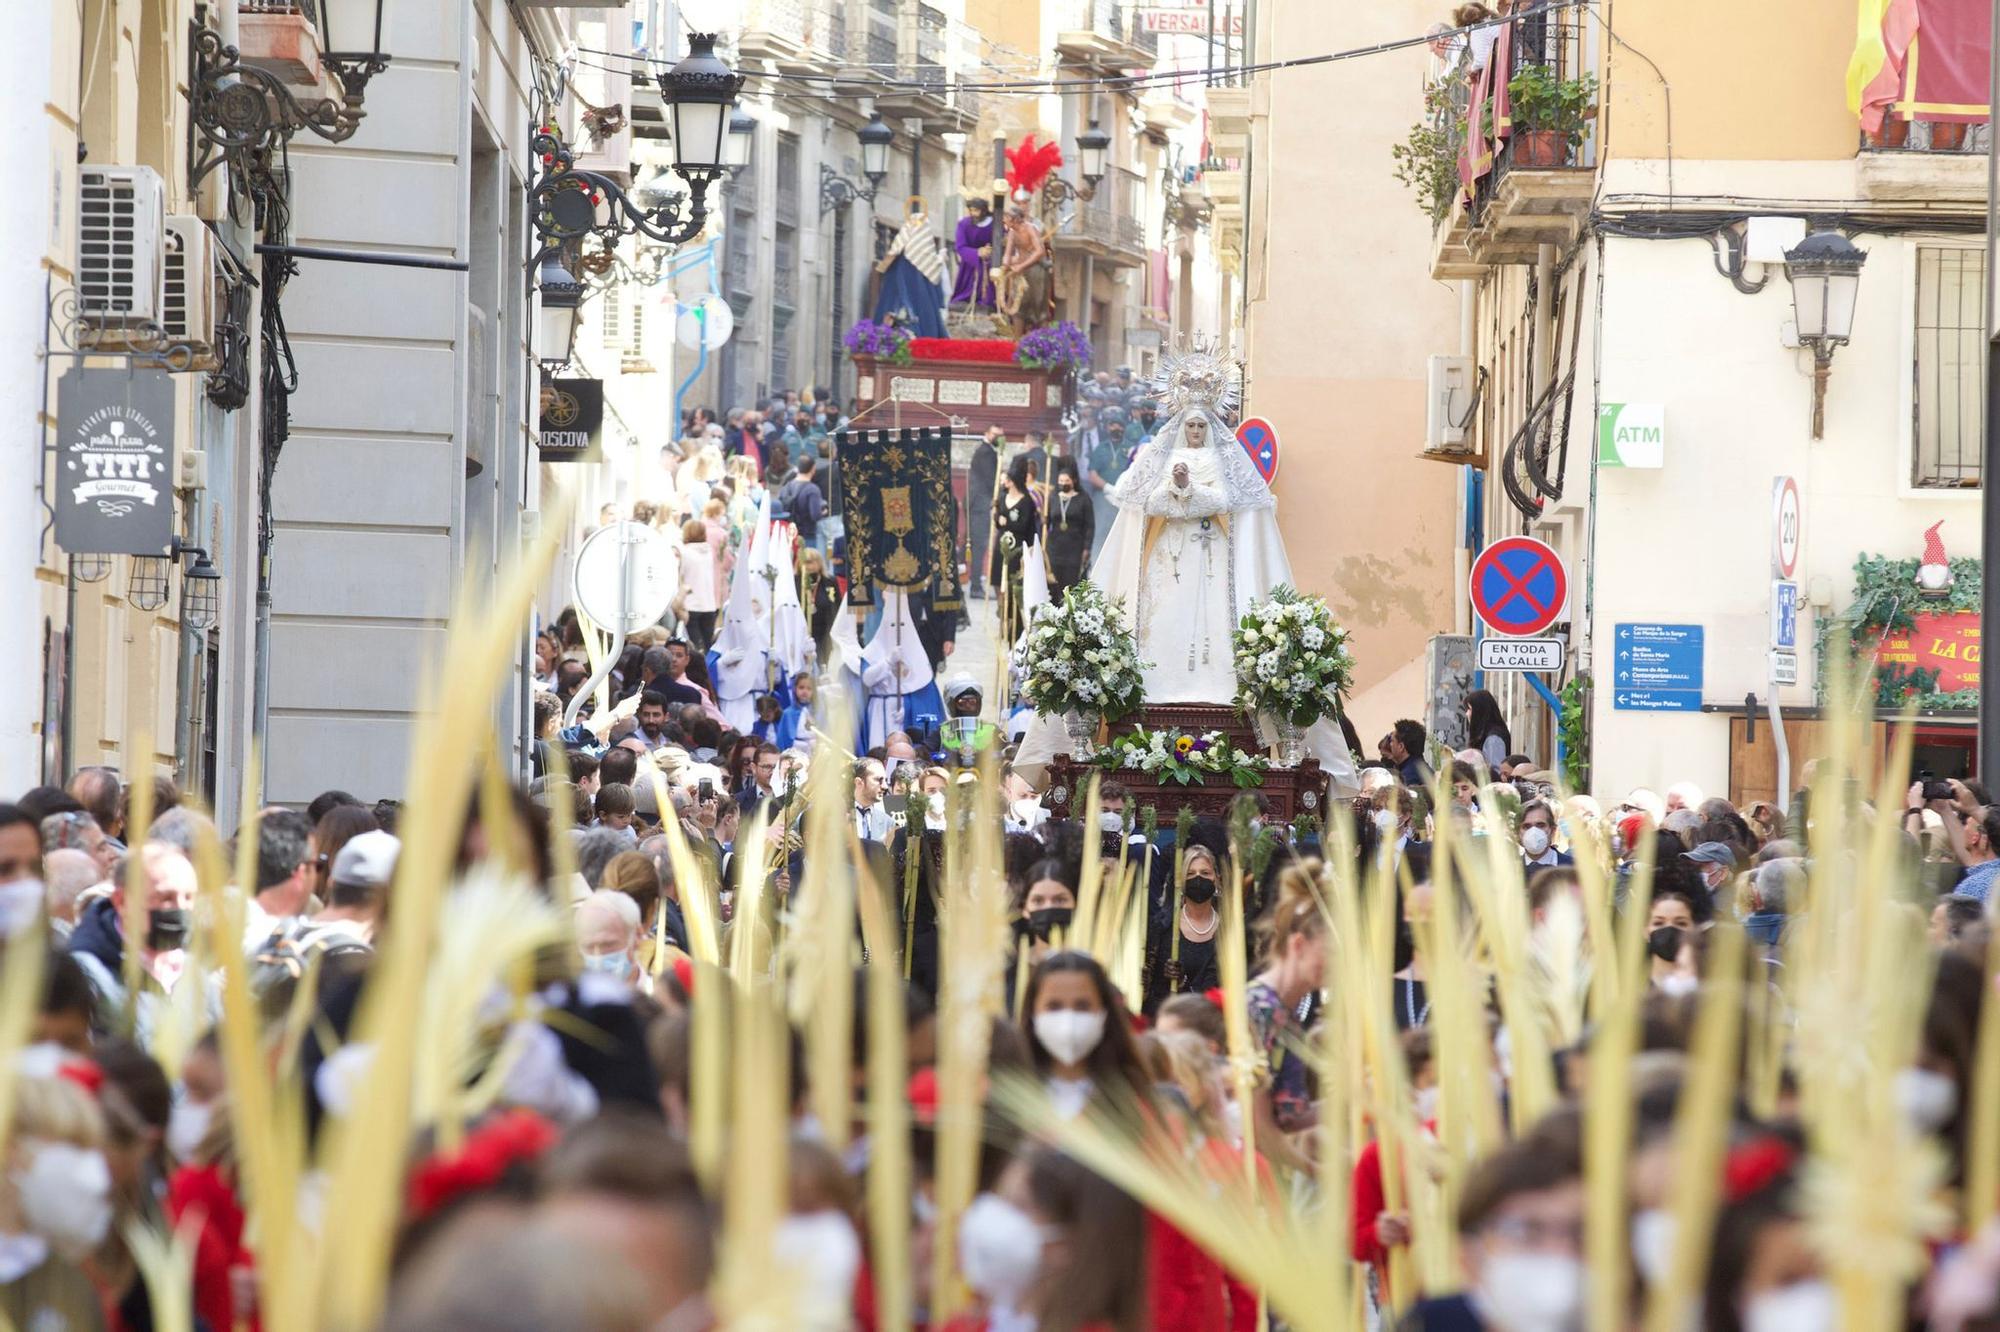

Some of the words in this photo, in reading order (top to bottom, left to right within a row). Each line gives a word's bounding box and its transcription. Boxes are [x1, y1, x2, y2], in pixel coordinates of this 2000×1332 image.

[1616, 426, 1660, 443] ATM
[81, 453, 151, 478] TITI
[95, 480, 136, 493] Gourmet
[1783, 511, 1796, 544] 20
[1492, 644, 1509, 653] EN
[1513, 645, 1547, 654] TODA
[1929, 639, 1957, 659] LA
[1962, 645, 1981, 662] C
[1489, 656, 1506, 665] LA
[1508, 656, 1549, 666] CALLE
